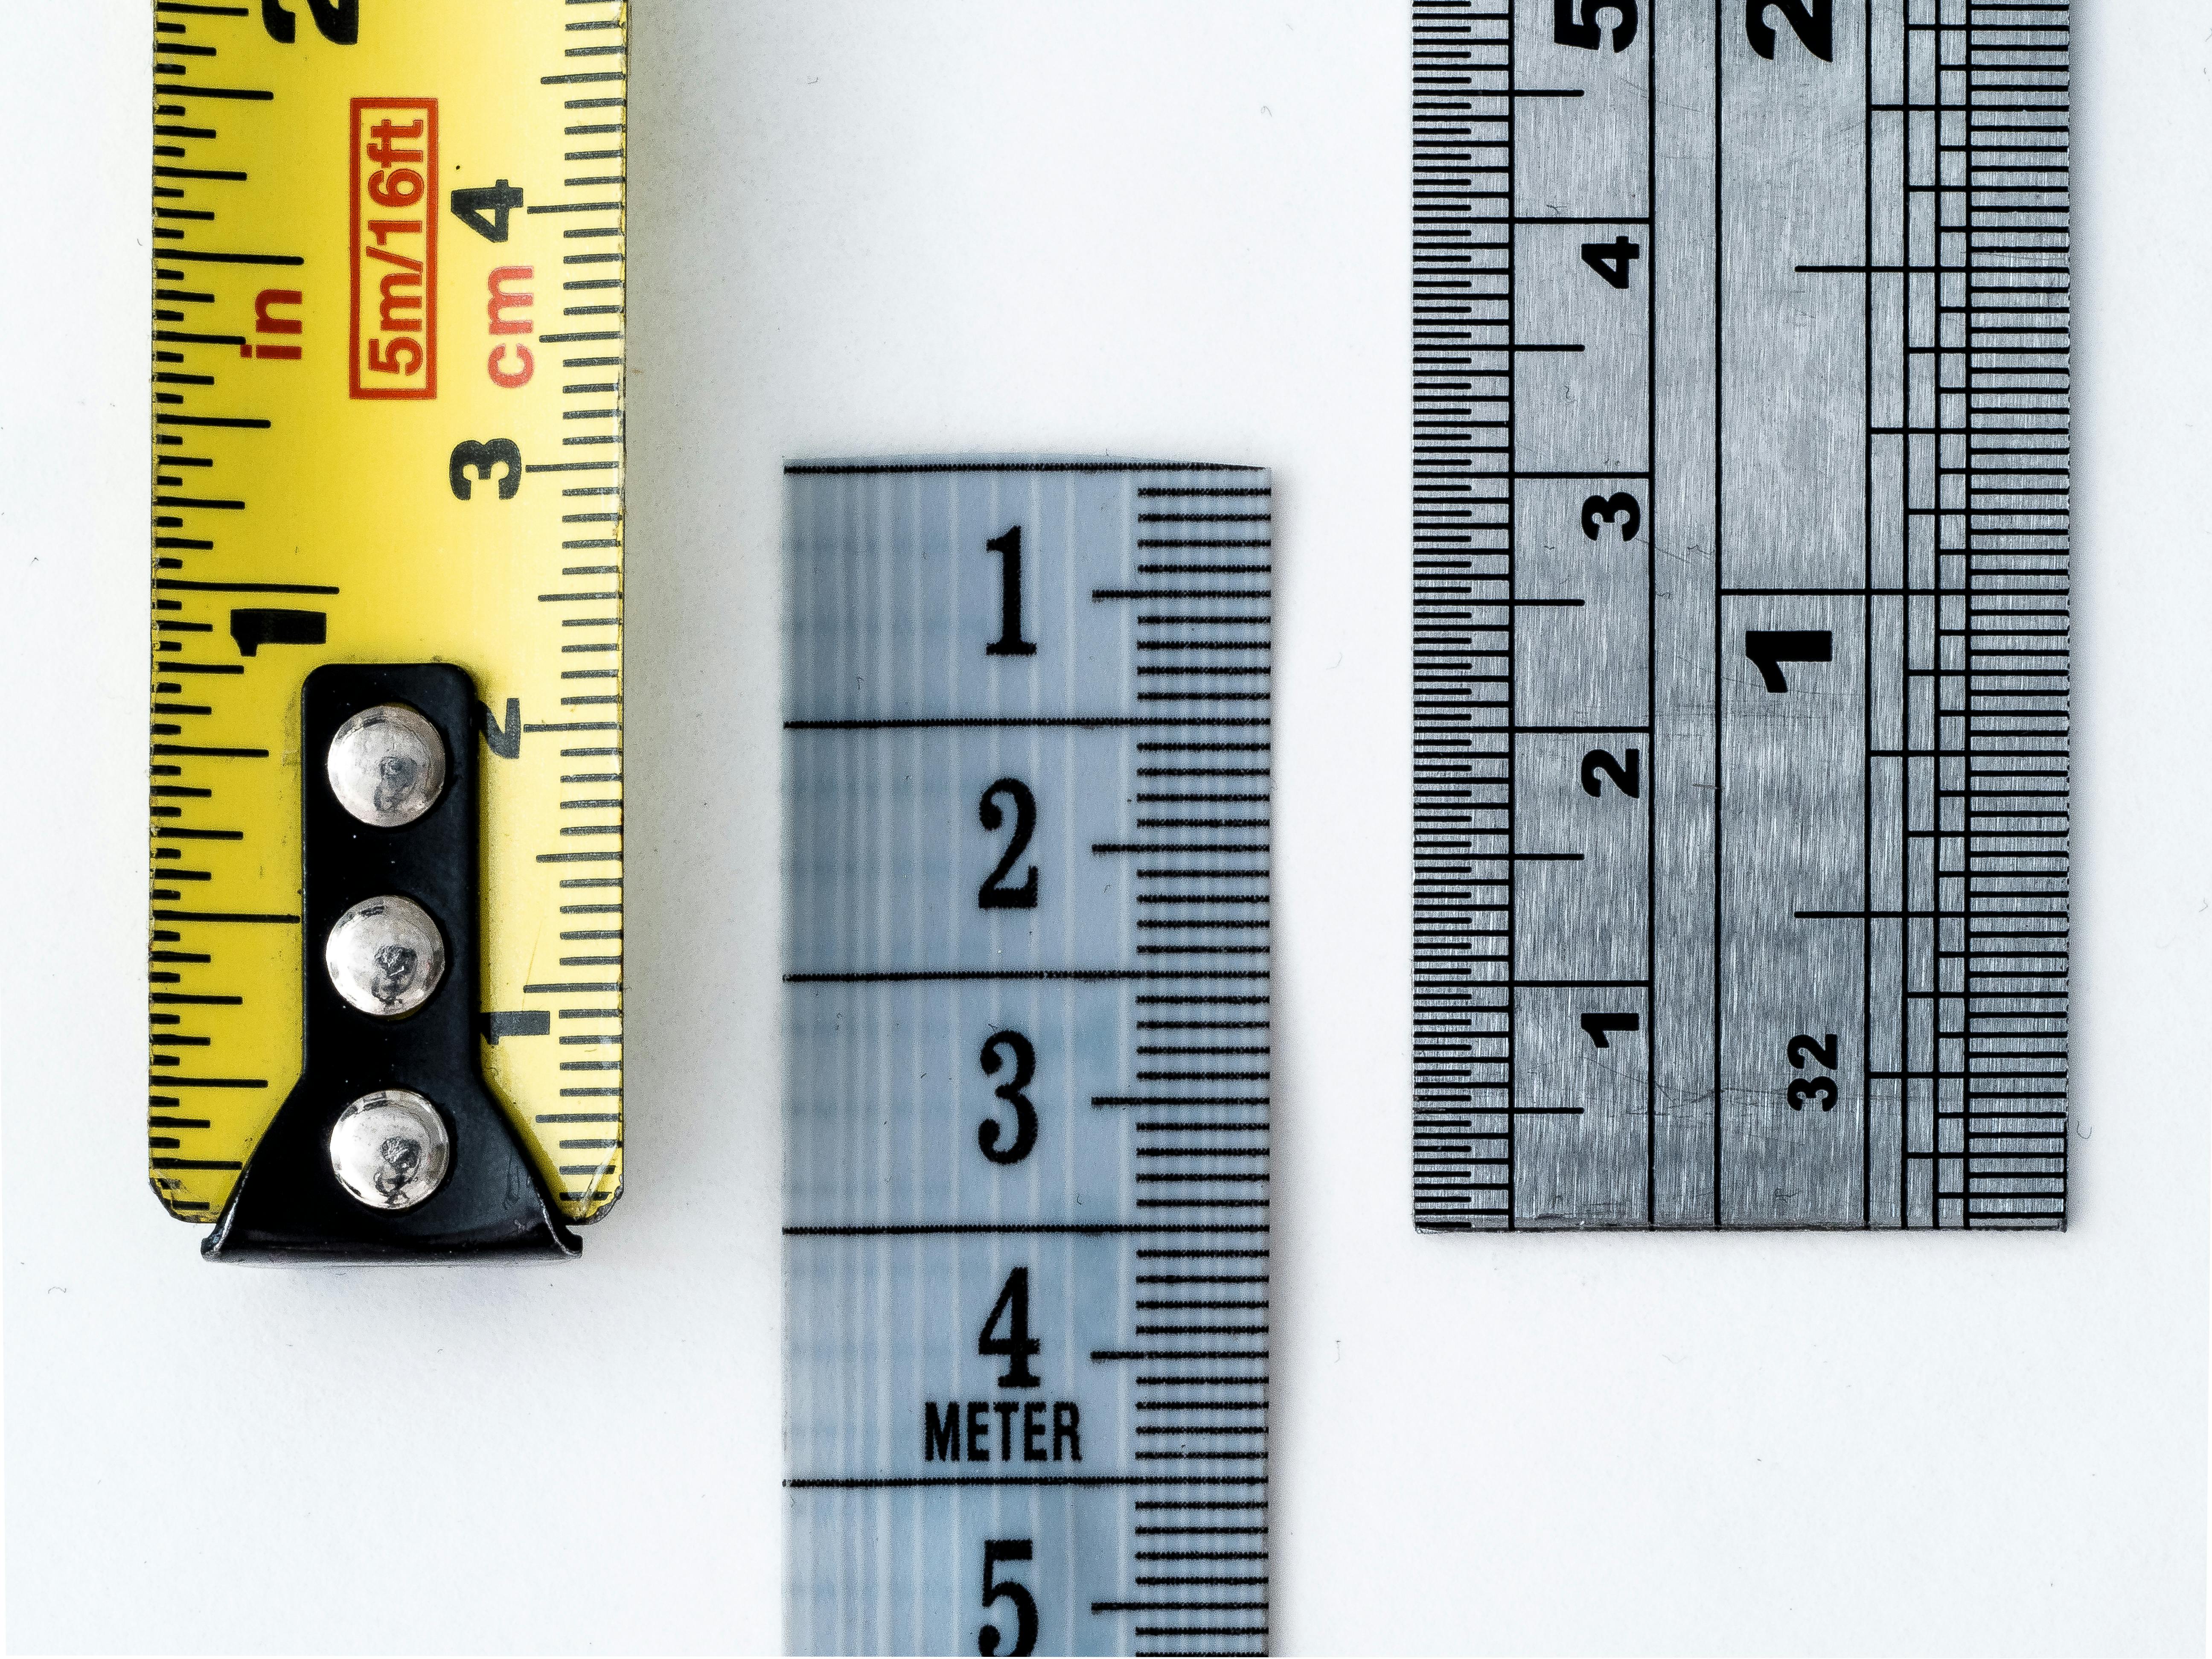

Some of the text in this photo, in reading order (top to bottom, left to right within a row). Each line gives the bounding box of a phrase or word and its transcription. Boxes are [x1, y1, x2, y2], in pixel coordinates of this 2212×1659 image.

[1554, 0, 1638, 53] 5
[1746, 0, 1833, 62] 2
[451, 179, 523, 242] 4
[367, 119, 423, 376] 5m/16ft
[1581, 236, 1639, 289] 4
[241, 289, 302, 359] in
[488, 265, 533, 387] cm
[449, 438, 521, 500] 3
[1581, 492, 1641, 542] 3
[987, 526, 1036, 655] 1
[230, 608, 326, 657] 1
[1745, 630, 1833, 693] 1
[1581, 749, 1640, 798] 2
[978, 778, 1038, 909] 2
[480, 1011, 550, 1045] 1
[1580, 1012, 1640, 1048] 1
[978, 1030, 1038, 1164] 3
[1787, 1033, 1838, 1112] 32
[978, 1266, 1040, 1388] 4
[925, 1401, 1082, 1461] METER
[978, 1539, 1039, 1657] 5
